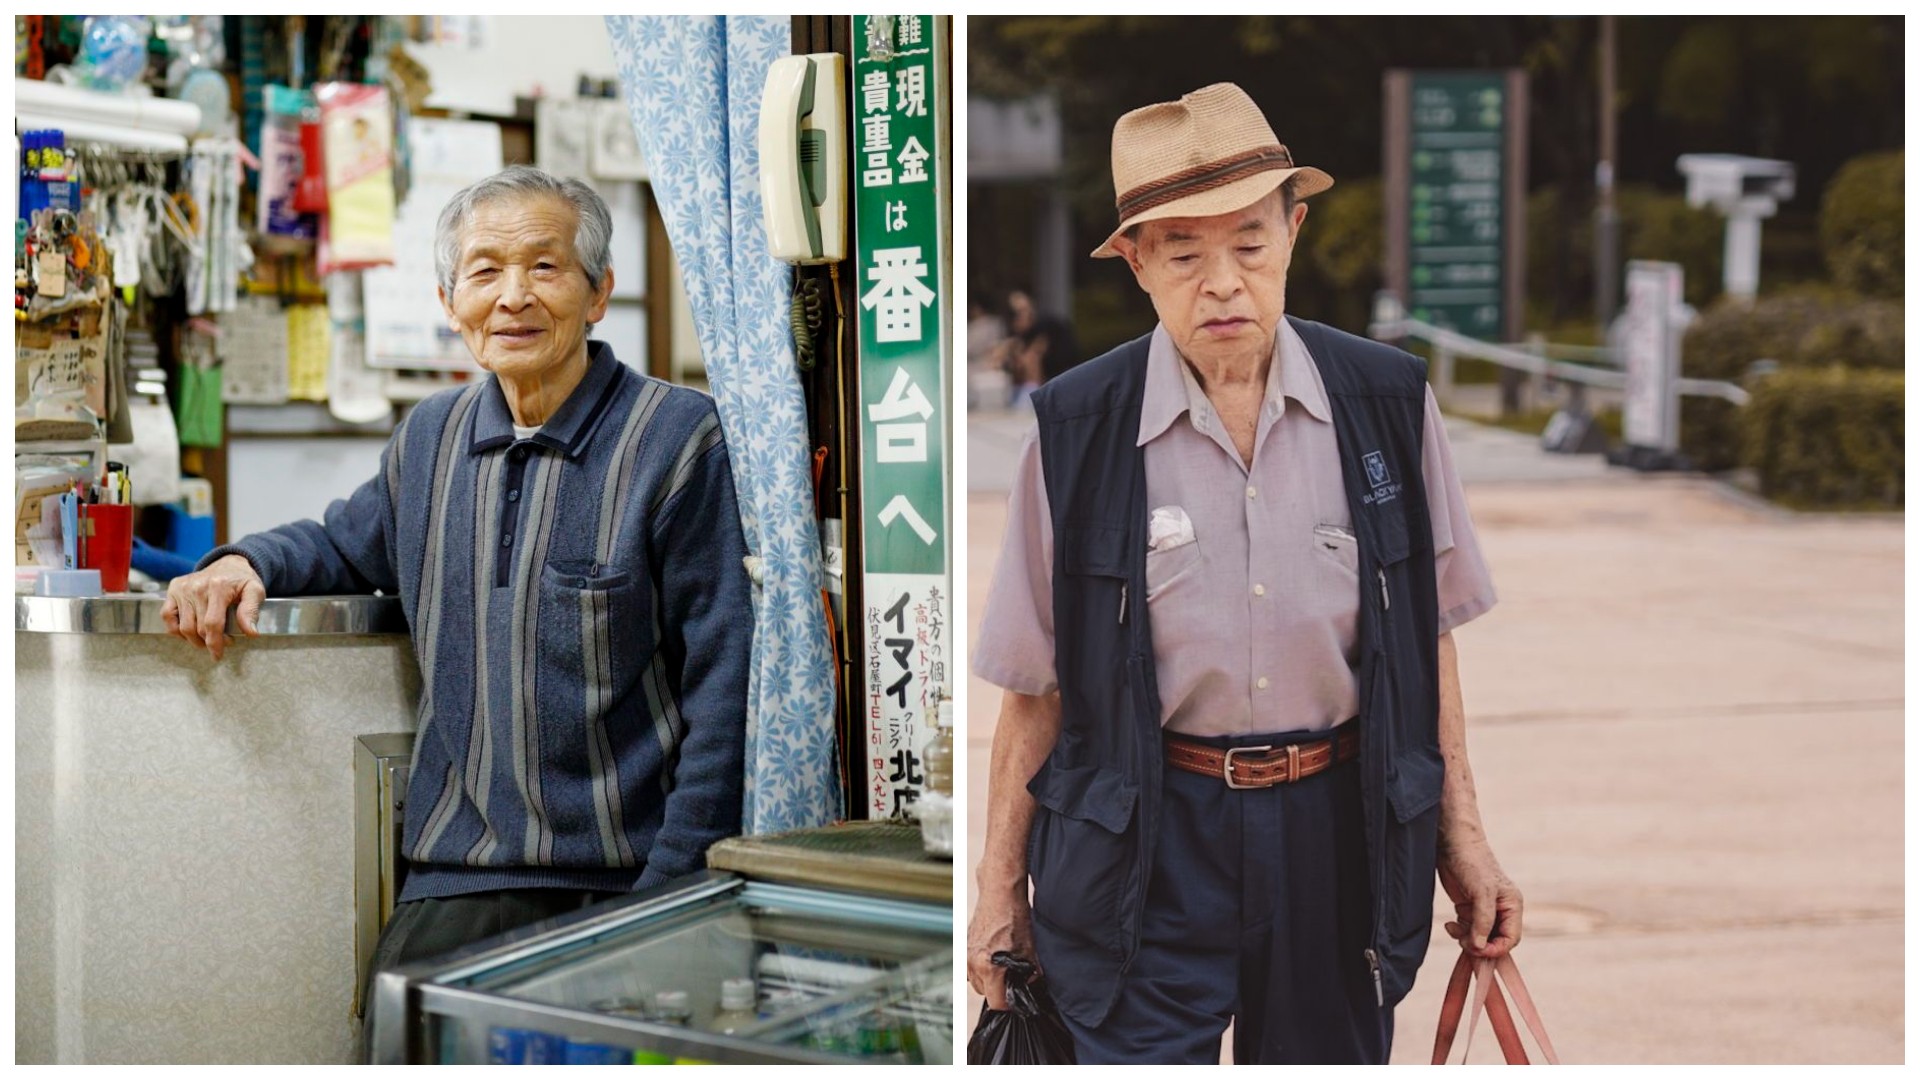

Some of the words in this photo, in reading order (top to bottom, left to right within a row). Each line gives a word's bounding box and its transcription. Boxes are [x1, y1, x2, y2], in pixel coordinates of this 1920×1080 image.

[861, 69, 892, 187] 貴重品
[896, 64, 930, 184] 現金
[884, 591, 915, 709] イマイ
